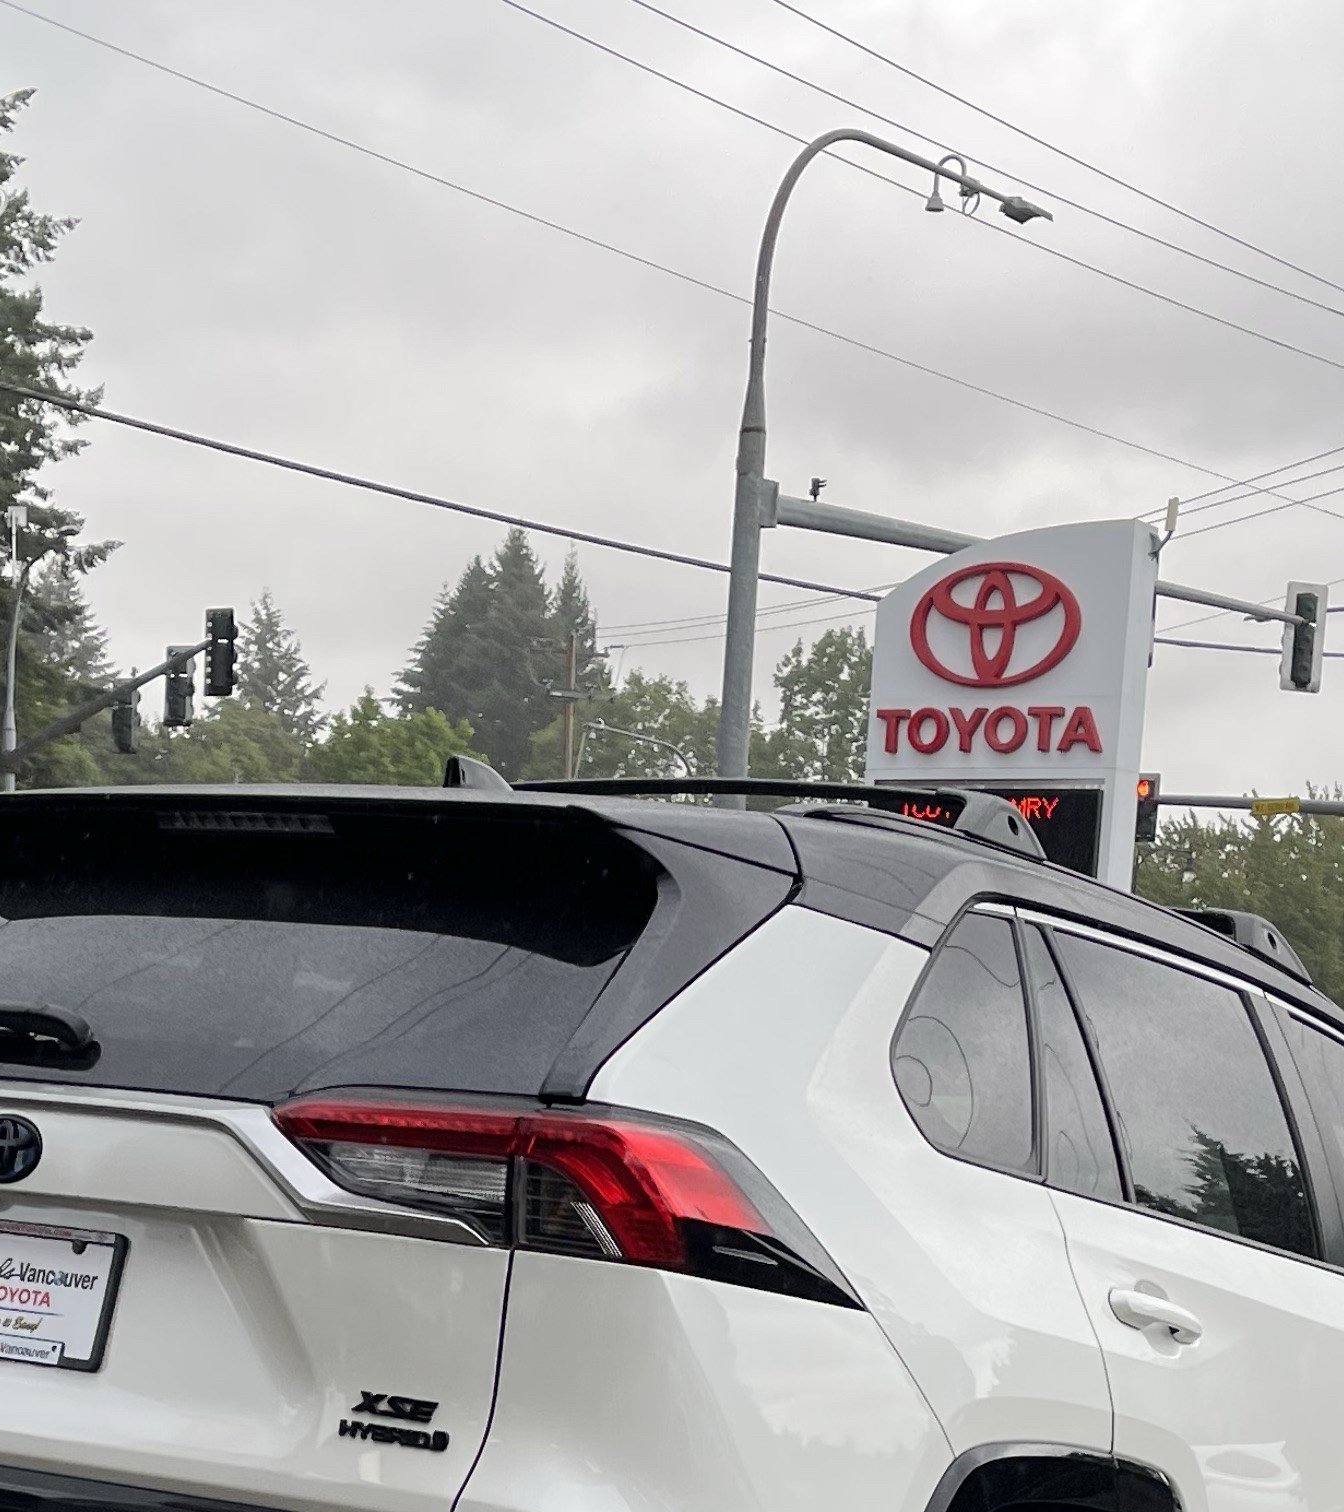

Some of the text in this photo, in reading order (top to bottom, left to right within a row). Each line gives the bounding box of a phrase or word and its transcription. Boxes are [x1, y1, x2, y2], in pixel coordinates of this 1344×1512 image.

[877, 706, 1103, 754] TOYOTA
[19, 1261, 99, 1290] Vancouver
[351, 1390, 439, 1423] XSE
